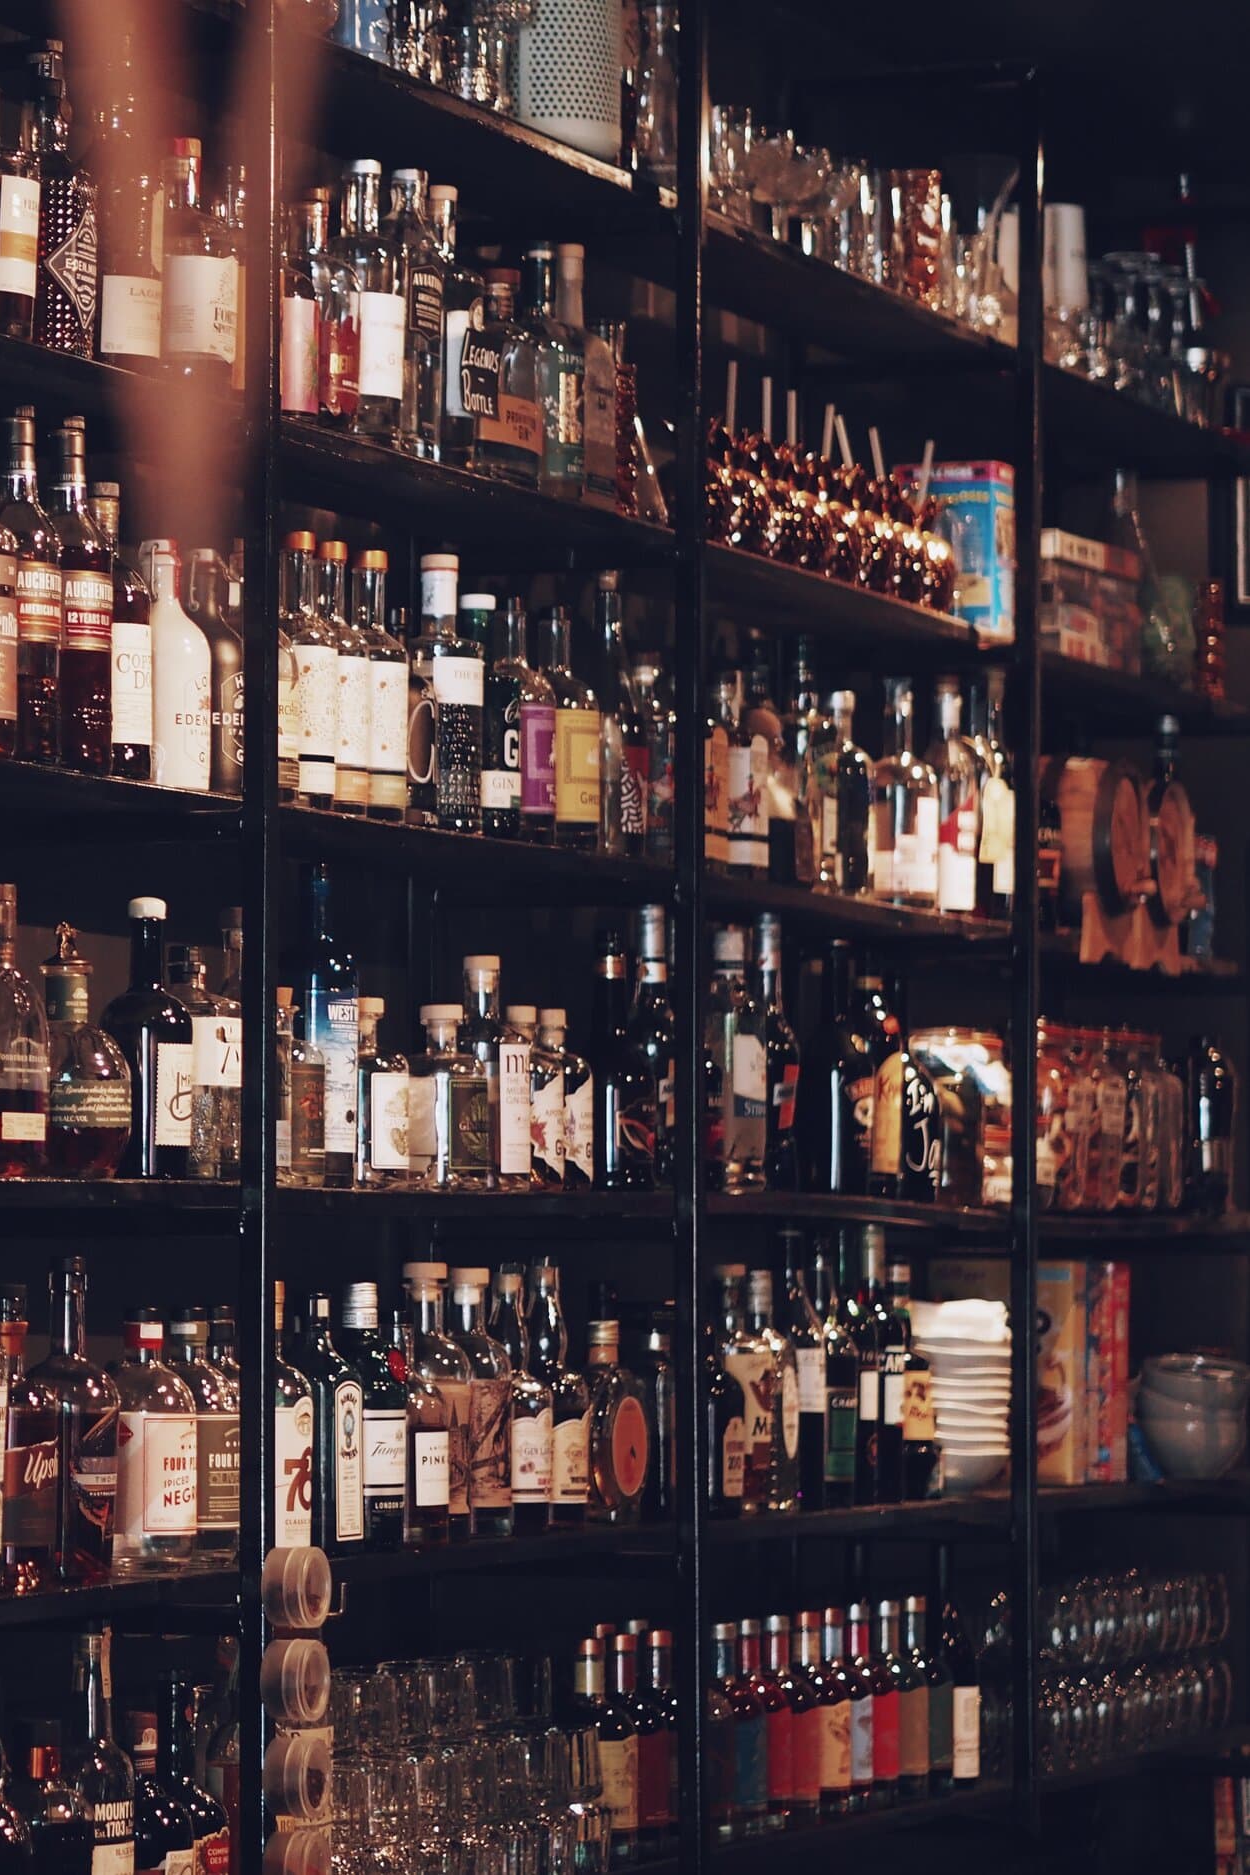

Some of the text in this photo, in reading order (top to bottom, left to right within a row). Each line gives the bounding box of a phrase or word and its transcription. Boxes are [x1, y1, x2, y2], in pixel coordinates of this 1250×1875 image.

[461, 331, 500, 374] LEGENDS
[460, 369, 495, 417] BOTTLE
[67, 612, 78, 624] 12
[79, 613, 100, 625] YEARS
[492, 775, 514, 790] GIN
[163, 1456, 187, 1472] FOUR
[208, 1453, 232, 1469] FOUR
[163, 1475, 189, 1489] SPICED
[94, 1801, 129, 1822] MOUNT
[105, 1820, 126, 1838] 1703
